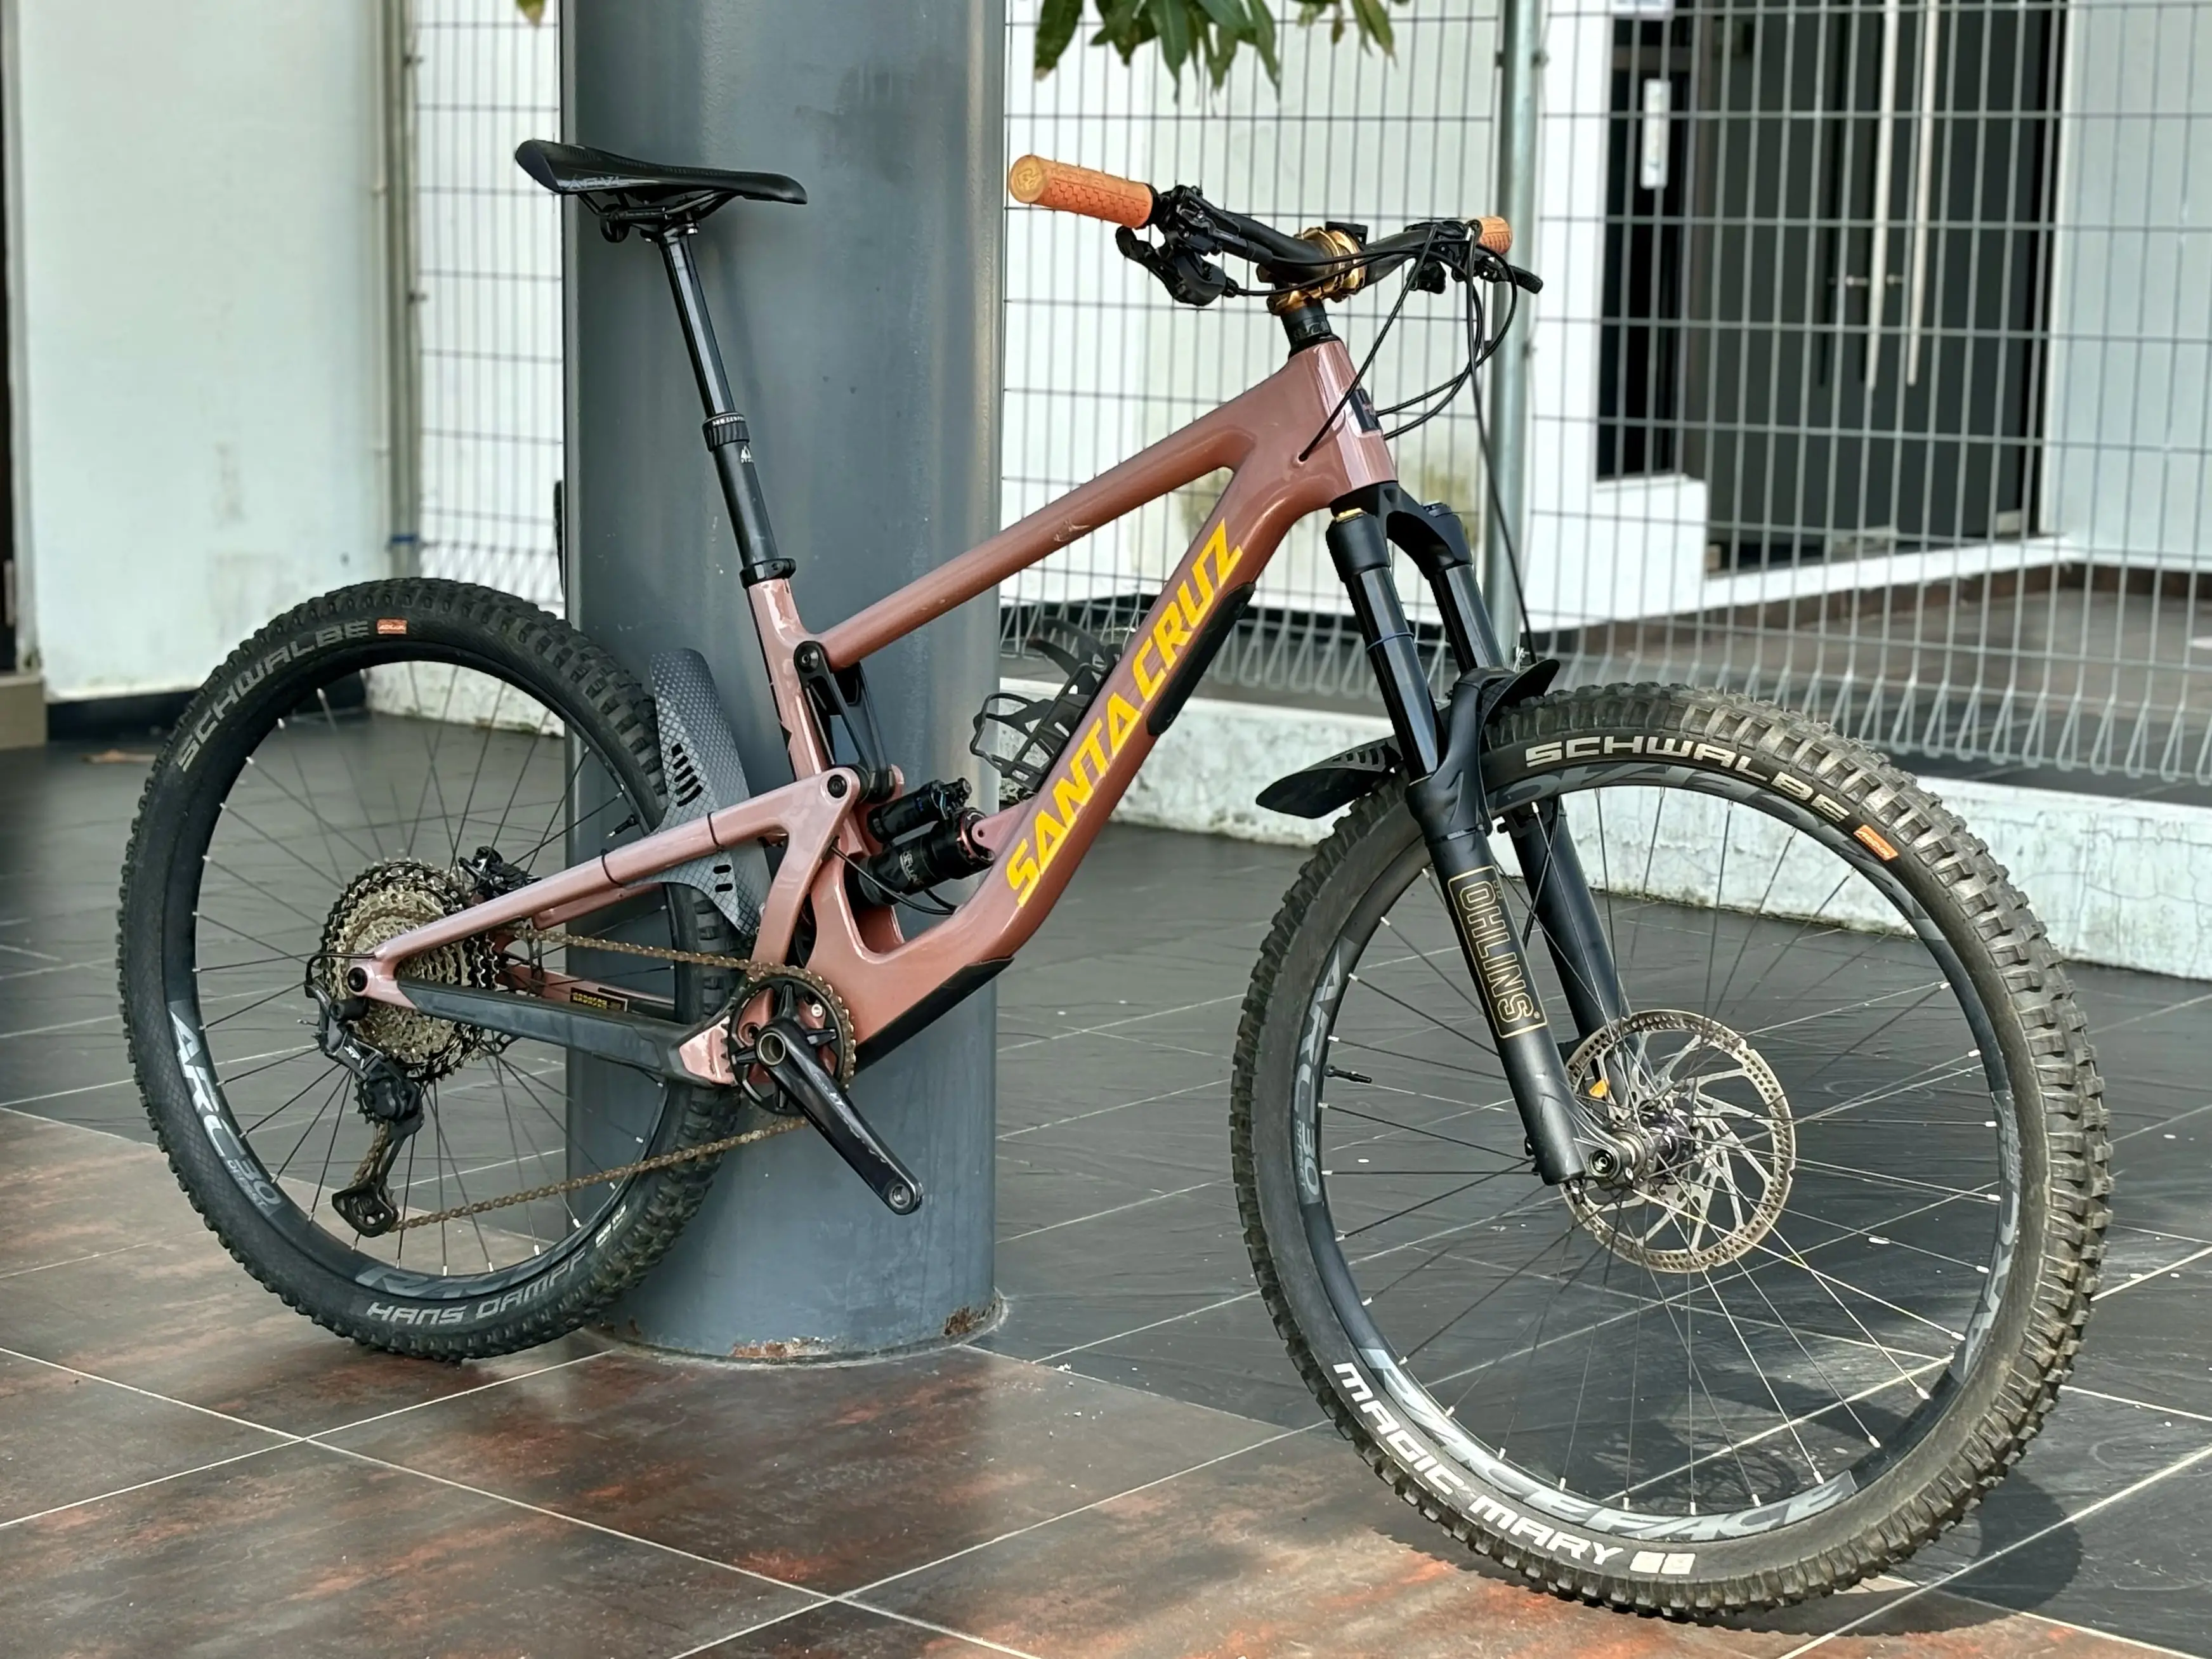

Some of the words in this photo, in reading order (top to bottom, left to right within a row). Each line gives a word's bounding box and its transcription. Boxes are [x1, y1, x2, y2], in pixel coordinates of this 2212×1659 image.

[178, 620, 369, 772] SCHWALBE
[1006, 692, 1141, 907] SANTA
[1133, 517, 1243, 702] CRUZ
[1526, 735, 1851, 823] SCHWALBE
[1458, 879, 1535, 1025] ÖHLINS
[169, 1009, 247, 1157] ARC
[233, 1158, 282, 1205] 30
[1302, 1122, 1320, 1196] 30
[367, 1302, 467, 1325] HANS
[476, 1250, 586, 1319] DAMPF
[1333, 1363, 1466, 1496] MAGIC
[1470, 1493, 1624, 1566] MARY
